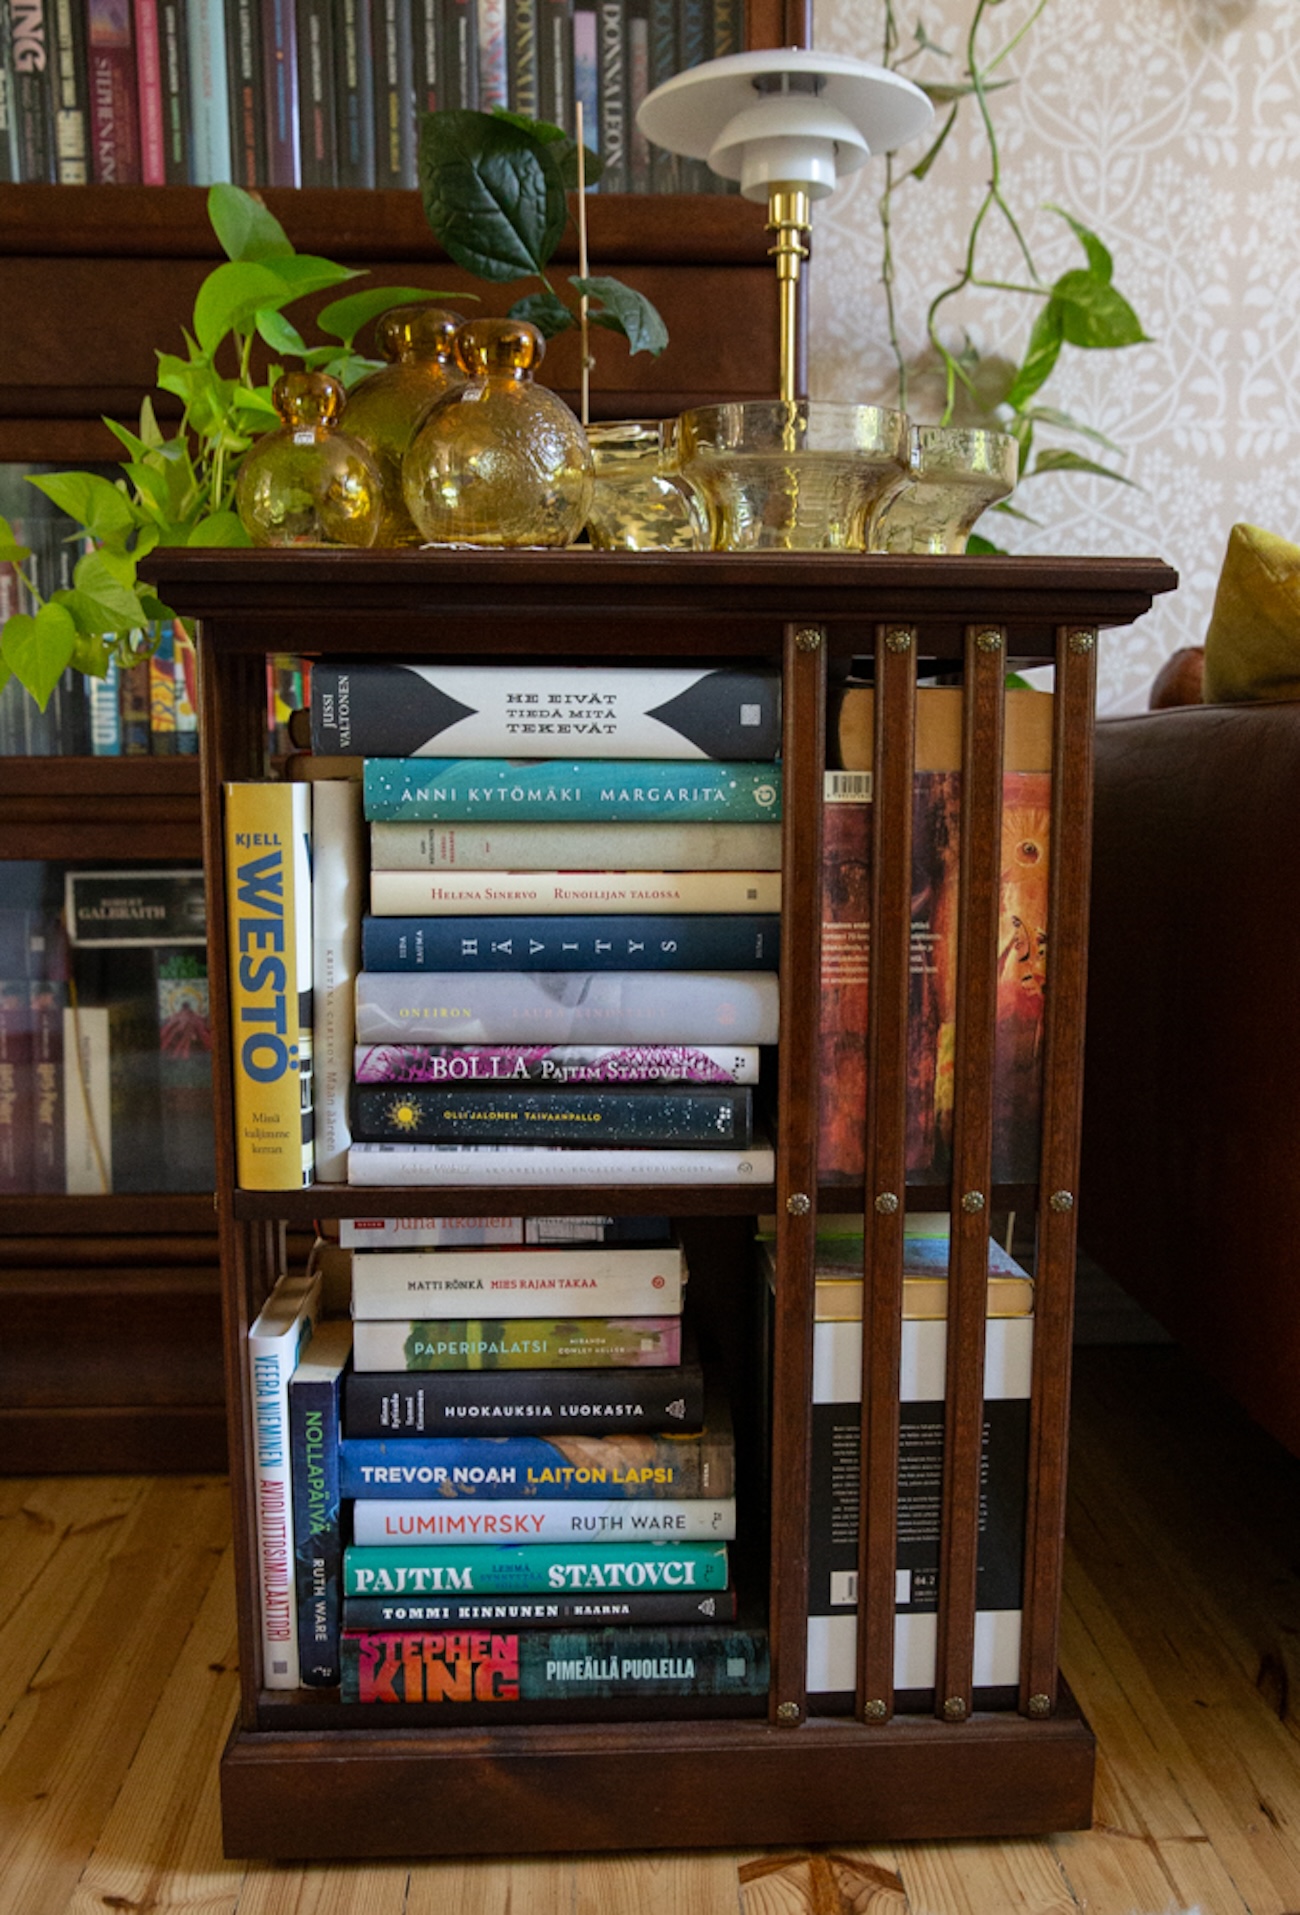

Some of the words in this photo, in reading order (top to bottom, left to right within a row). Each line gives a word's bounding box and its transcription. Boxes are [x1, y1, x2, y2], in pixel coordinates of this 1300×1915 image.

[603, 4, 622, 97] DONNA
[604, 101, 622, 167] LEON
[506, 693, 539, 704] HE
[548, 692, 617, 704] EIVÄT
[322, 693, 337, 729] JUSSI
[338, 675, 351, 748] VALTONEN
[506, 708, 563, 719] TIEDÄ
[569, 707, 617, 719] MITÄ
[506, 723, 617, 734] TEKEVÄT
[401, 788, 457, 801] ANNI
[468, 785, 581, 801] KYTÖMÄKI
[600, 788, 727, 801] MARGARITA
[235, 833, 282, 848] KJELL
[237, 850, 299, 1083] WESTÖ
[399, 1008, 472, 1018] ONEIRON
[431, 1056, 531, 1080] BOLLA
[443, 1111, 468, 1119] OLLI
[471, 1111, 518, 1120] JALONEN
[524, 1112, 602, 1121] TAIVAANPALLO
[408, 1280, 442, 1290] MATTI
[445, 1278, 484, 1290] RÖNKÄ
[490, 1280, 517, 1289] MIES
[519, 1279, 555, 1289] RAJAN
[558, 1278, 598, 1288] TAKAA
[414, 1341, 547, 1355] PAPERIPALATSI
[255, 1355, 280, 1397] VEERA
[445, 1406, 552, 1417] HUOKAUKSIA
[560, 1405, 643, 1416] LUOKASTA
[257, 1401, 283, 1467] NIEMINEN
[305, 1411, 331, 1535] NOLLAPÄIVÄ
[361, 1466, 447, 1483] TREVOR
[453, 1466, 516, 1483] NOAH
[527, 1467, 606, 1483] LAITON
[612, 1467, 673, 1483] LAPSI
[385, 1514, 545, 1534] LUMIMYRSKY
[571, 1516, 623, 1531] RUTH
[632, 1515, 686, 1529] WARE
[313, 1558, 325, 1596] RUTH
[354, 1567, 474, 1592] PAJTIM
[548, 1561, 696, 1588] STATOVCI
[315, 1602, 327, 1641] WARE
[382, 1607, 450, 1619] TOMMI
[459, 1606, 559, 1618] KINNUNEN
[574, 1604, 630, 1615] KAARNA
[359, 1634, 519, 1663] STEPHEN
[546, 1656, 620, 1680] PIMEÄLLÄ
[622, 1657, 695, 1679] PUOLELLA
[359, 1658, 520, 1703] KING
